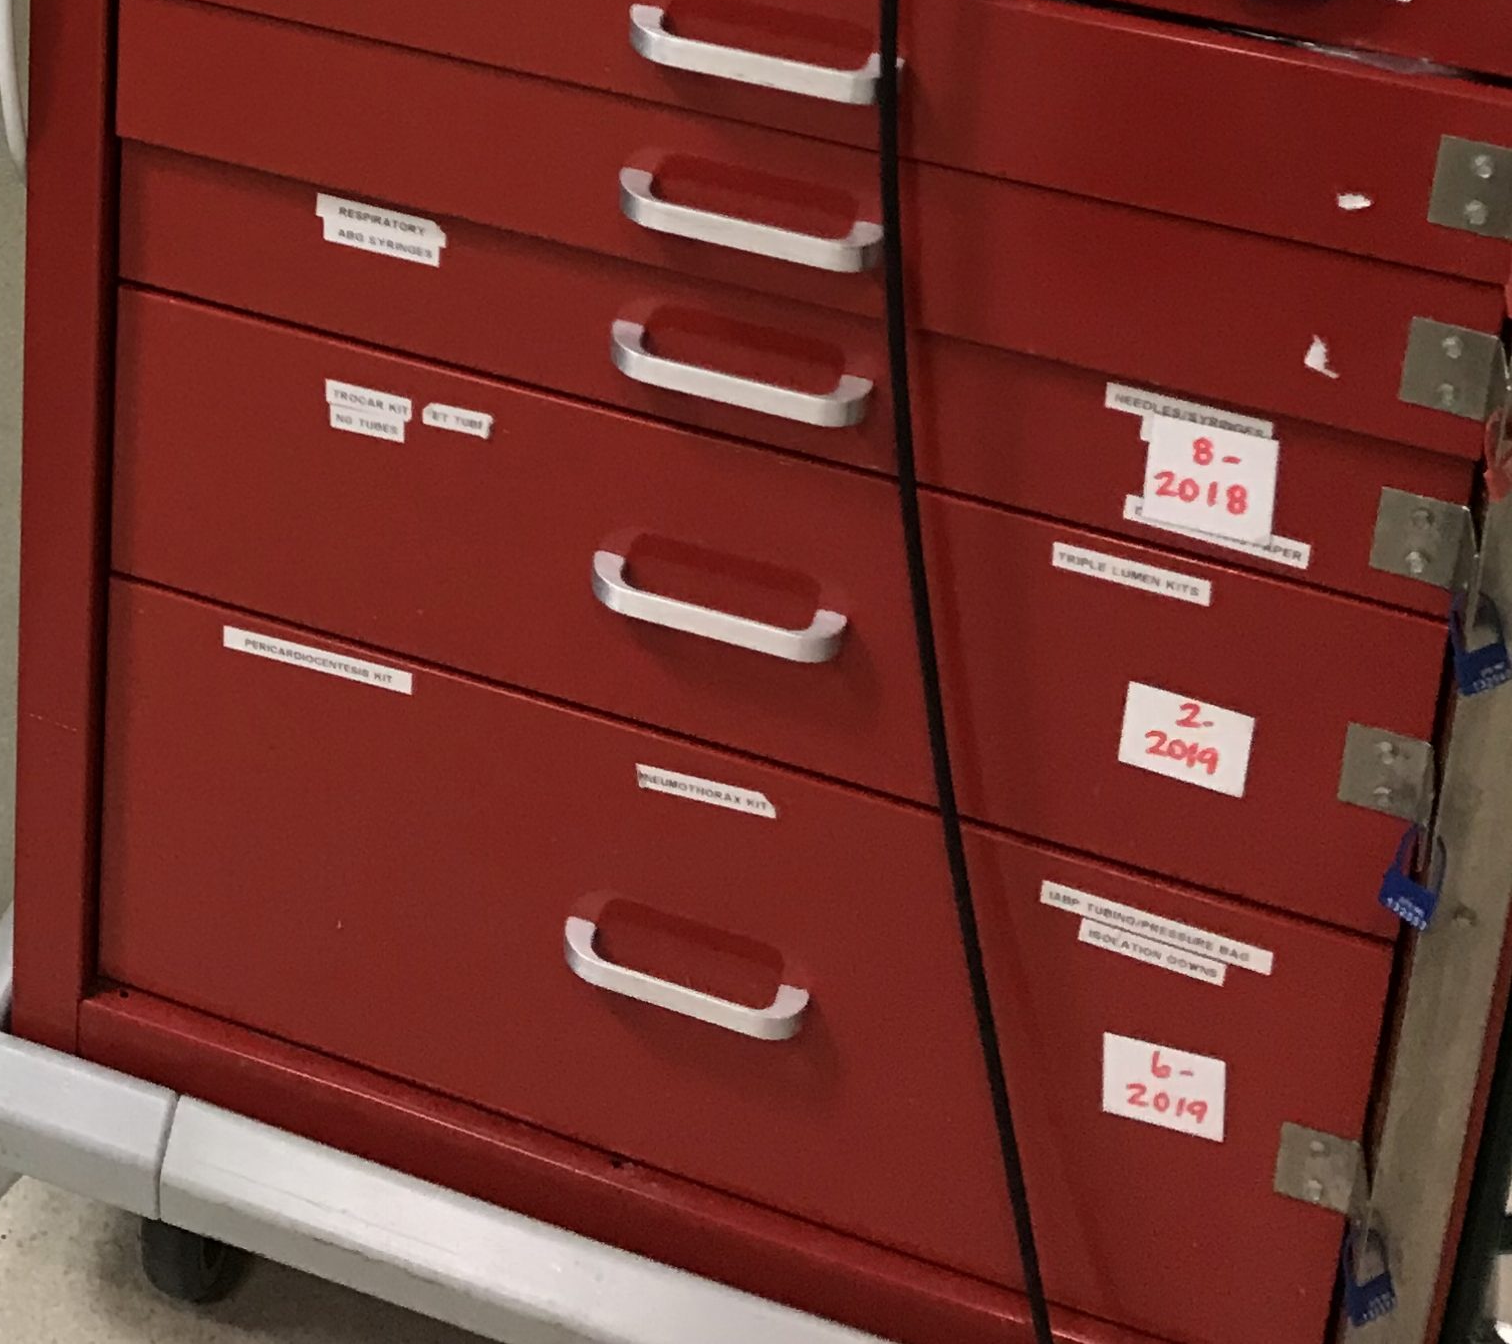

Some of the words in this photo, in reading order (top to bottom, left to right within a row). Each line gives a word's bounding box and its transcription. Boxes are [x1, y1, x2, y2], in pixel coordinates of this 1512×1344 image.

[339, 206, 426, 237] RESPIRATORY
[338, 228, 364, 243] ABG
[369, 235, 433, 259] SYRINGES
[333, 389, 385, 412] TROCAR
[389, 403, 408, 416] KIT
[431, 411, 448, 423] ET
[359, 419, 399, 435] TUBES
[1153, 470, 1249, 516] 2018
[1254, 541, 1303, 562] APER
[1058, 551, 1106, 572] TRIPLE
[1112, 566, 1161, 588] LUMEN
[1166, 580, 1200, 598] KITS
[244, 638, 370, 678] PERICARDIOCENTESIS
[373, 671, 393, 684] KIT
[1144, 730, 1220, 776] 2019
[746, 797, 768, 811] KIT
[1048, 889, 1081, 909] IABP
[1219, 943, 1251, 963] BAG
[1088, 928, 1163, 961] ISOLATION
[1166, 953, 1218, 979] GOWNS
[1125, 1082, 1209, 1125] 2019
